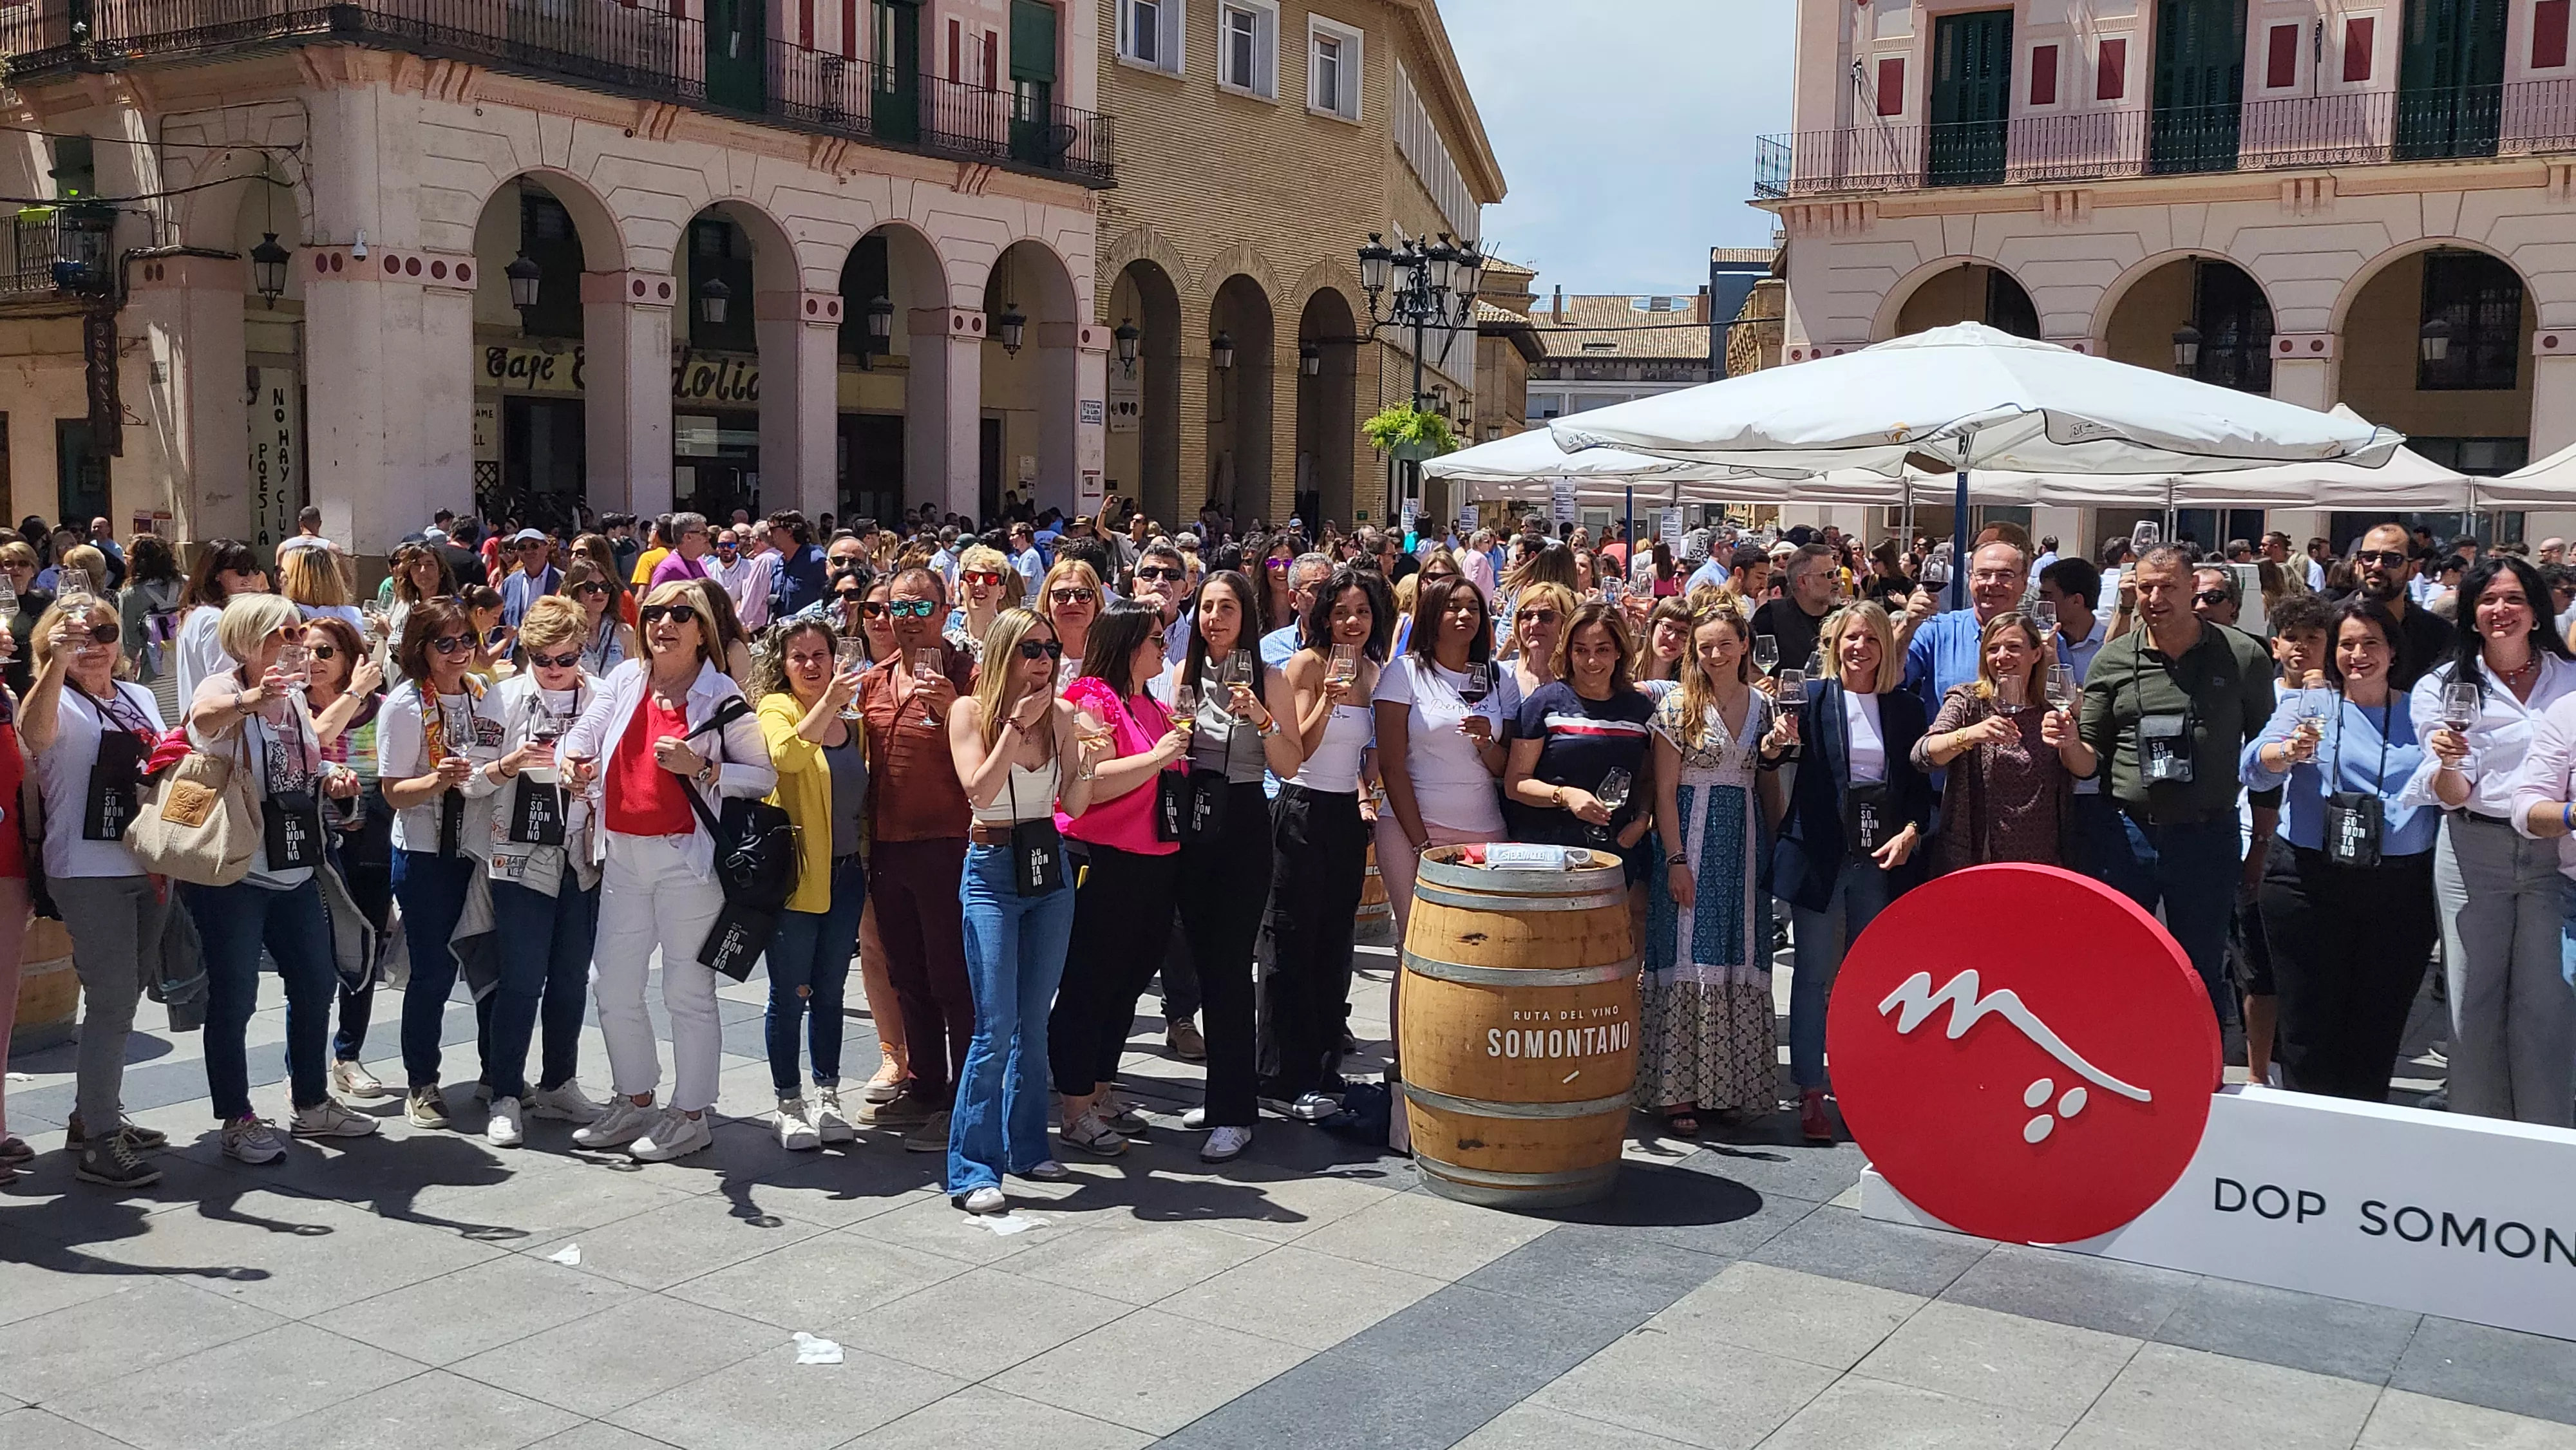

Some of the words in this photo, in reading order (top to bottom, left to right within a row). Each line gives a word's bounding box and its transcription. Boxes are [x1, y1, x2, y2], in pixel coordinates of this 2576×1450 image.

[273, 388, 285, 422] NO
[278, 429, 289, 482] HAY
[258, 442, 269, 545] POESIA
[2152, 742, 2164, 752] SO
[2152, 758, 2165, 769] TA
[2153, 767, 2166, 778] NO
[104, 796, 116, 806] SO
[530, 800, 542, 811] SO
[104, 806, 124, 817] MON
[529, 811, 551, 822] MON
[1861, 810, 1871, 819] SO
[104, 816, 114, 827] TA
[285, 820, 296, 831] SO
[528, 820, 539, 831] TA
[1861, 819, 1879, 829] MON
[2342, 816, 2357, 827] SO
[102, 827, 116, 837] NO
[286, 829, 305, 841] MON
[527, 830, 540, 840] NO
[1861, 828, 1871, 837] TA
[2342, 825, 2365, 838] MON
[286, 840, 297, 851] TA
[1861, 837, 1872, 847] NO
[2340, 835, 2354, 846] TA
[287, 851, 299, 860] NO
[2340, 845, 2354, 857] NO
[1031, 853, 1048, 866] MON
[1032, 865, 1041, 876] TA
[1033, 874, 1042, 887] NO
[726, 929, 739, 941] SO
[721, 939, 743, 955] MON
[717, 947, 729, 961] TA
[712, 957, 726, 969] NO
[1513, 1010, 1551, 1021] RUTA
[1560, 1010, 1584, 1020] DEL
[1591, 1005, 1618, 1018] VINO
[1487, 1021, 1629, 1058] SOMONTANO
[2215, 1177, 2326, 1223] DOP
[2360, 1200, 2576, 1267] SOMON
